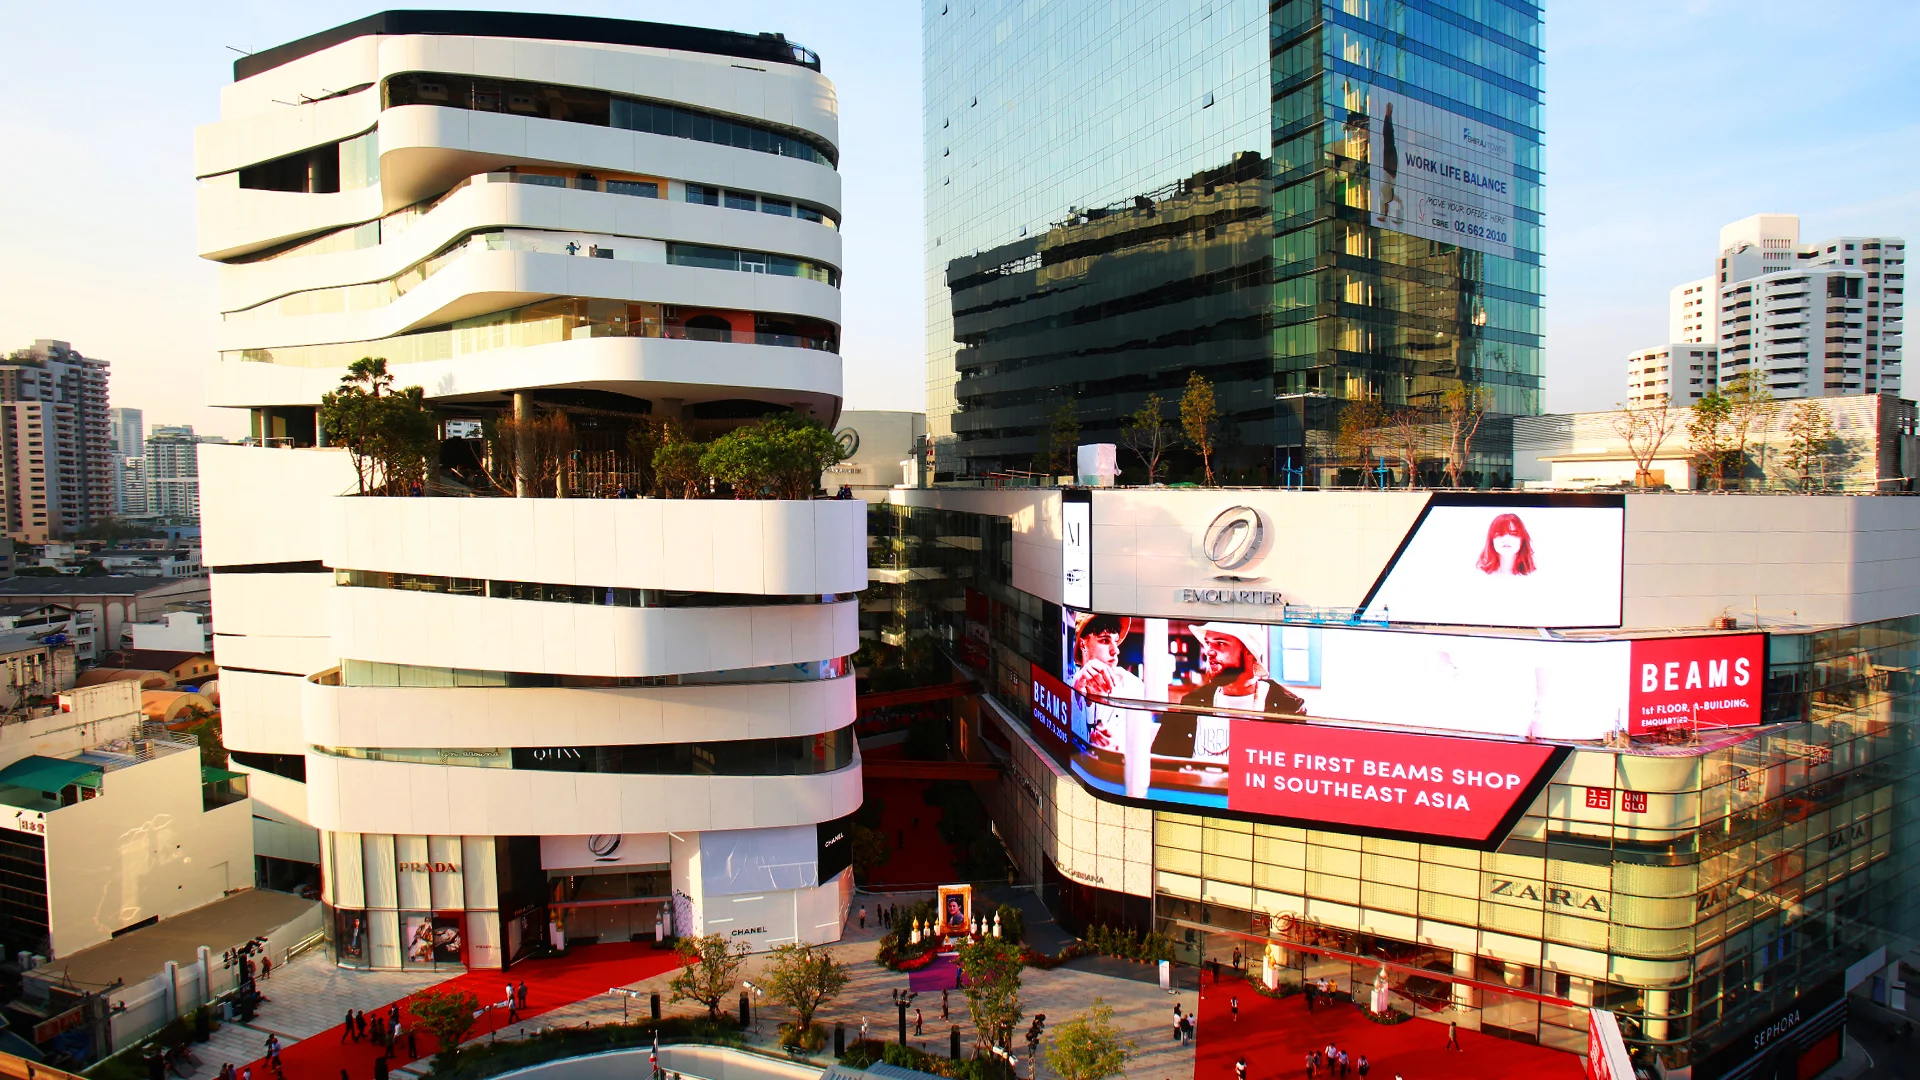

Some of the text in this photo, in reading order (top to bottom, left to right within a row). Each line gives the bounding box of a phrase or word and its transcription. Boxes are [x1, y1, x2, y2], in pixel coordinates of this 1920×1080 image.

[1467, 135, 1487, 148] BHIRAJ
[1487, 142, 1507, 155] TOWER
[1405, 152, 1507, 194] WORK LIFE BALANCE
[1425, 196, 1445, 209] MOVE
[1447, 201, 1464, 214] YOUR
[1466, 207, 1489, 220] OFFICE
[1489, 213, 1507, 225] HERE
[1431, 218, 1507, 244] CBRE 02 662 2010
[1183, 589, 1283, 606] EMQUARTIER
[1641, 656, 1750, 693] BEAMS
[1033, 680, 1068, 726] BEAMS
[1641, 706, 1655, 716] 1st
[1656, 703, 1690, 715] FLOOR,
[1033, 707, 1046, 725] OPEN
[1641, 716, 1689, 727] EMQUARTIER
[1245, 748, 1521, 790] THE FIRST BEAMS SHOP
[1245, 772, 1471, 811] IN SOUTHEAST ASIA
[1624, 792, 1644, 802] UNI
[1624, 801, 1645, 812] QLO
[824, 832, 844, 848] CHANEL
[399, 862, 458, 873] PRADA
[1490, 878, 1607, 913] ZARA
[731, 926, 767, 937] CHANEL
[1754, 1009, 1801, 1050] SEPHORA
